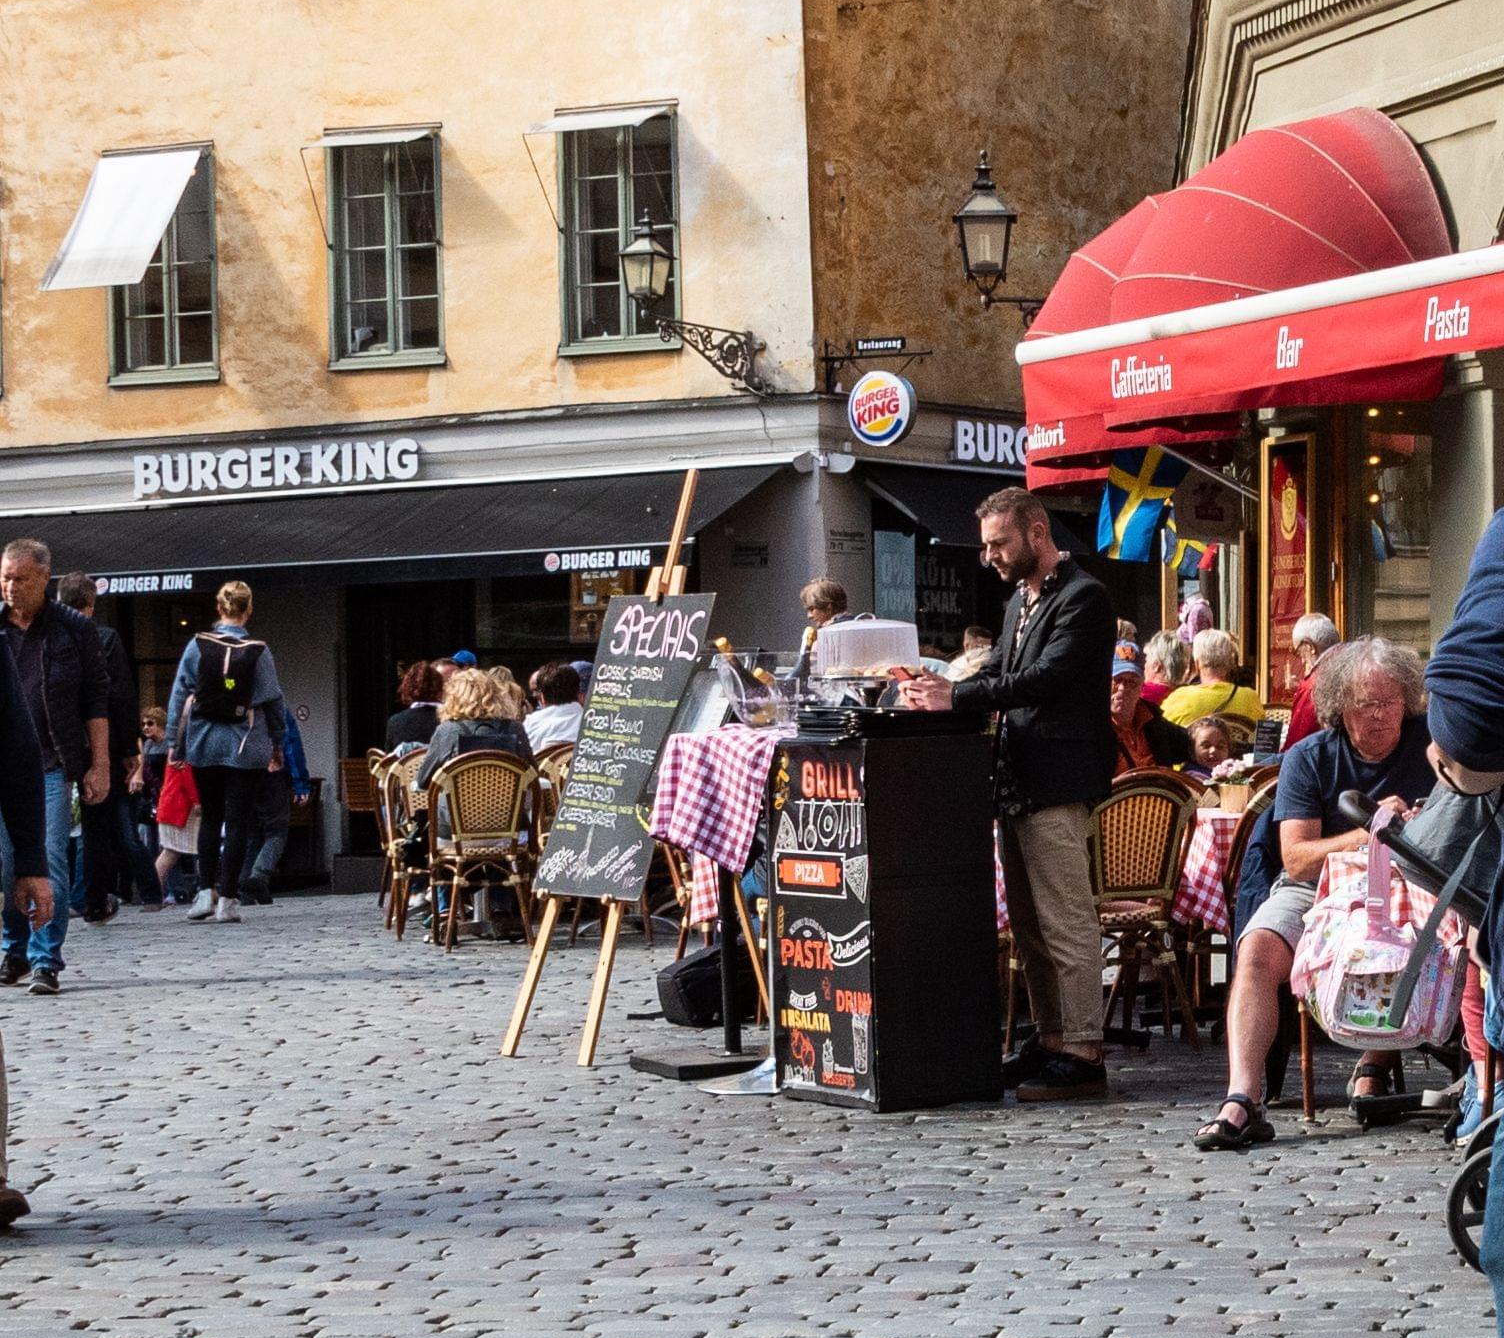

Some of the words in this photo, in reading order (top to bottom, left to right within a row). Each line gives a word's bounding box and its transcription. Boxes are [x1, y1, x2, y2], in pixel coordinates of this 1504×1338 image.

[857, 339, 902, 351] Restaurang
[1110, 354, 1173, 399] Caffeteria
[1275, 325, 1304, 370] Bar
[1423, 296, 1471, 344] Pasta
[854, 385, 899, 412] BURGER
[855, 396, 901, 428] KING
[133, 444, 302, 495] BURGER
[310, 438, 420, 485] KING
[560, 551, 615, 570] BURGER
[618, 549, 651, 567] KING
[108, 575, 160, 595] BURGER
[162, 573, 193, 592] KING
[609, 603, 706, 663] SPECIALS.
[800, 760, 860, 799] GRILL
[794, 863, 826, 884] PIZZA
[780, 938, 834, 971] PASTA
[833, 933, 870, 960] Delicious
[781, 1008, 832, 1034] INSALATA
